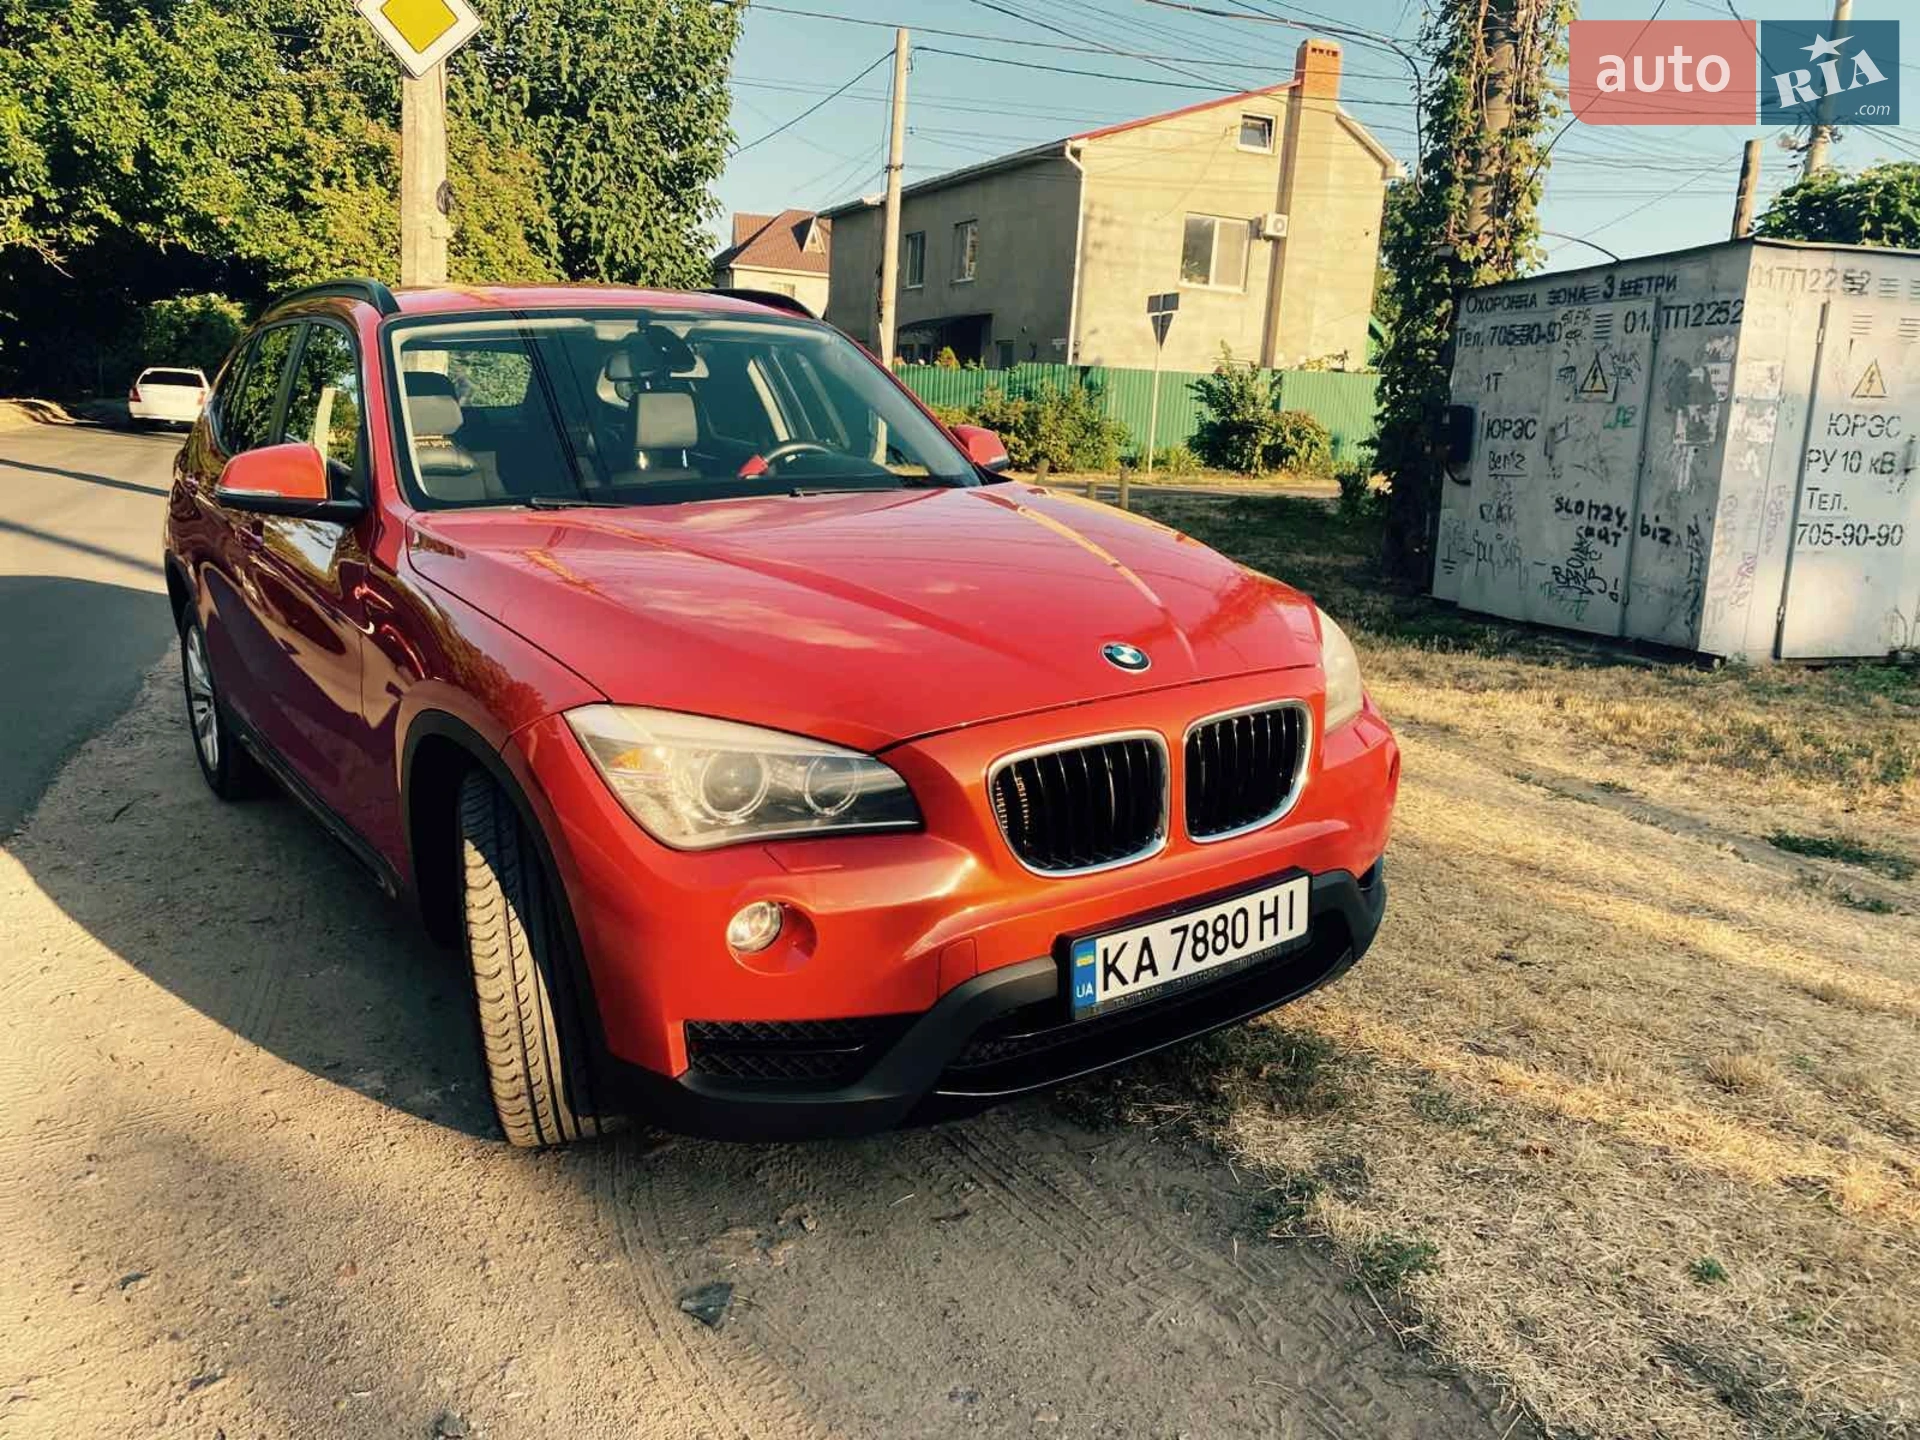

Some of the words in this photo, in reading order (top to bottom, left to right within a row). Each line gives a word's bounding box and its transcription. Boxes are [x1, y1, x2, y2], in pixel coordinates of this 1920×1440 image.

[1603, 274, 1615, 300] 3
[1485, 417, 1538, 441] ЮРЭС
[1826, 412, 1902, 439] ЮРЭС
[1806, 448, 1838, 473] РУ
[1841, 450, 1863, 474] 10
[1797, 523, 1904, 547] 705-90-90
[1103, 936, 1159, 992] KA
[1170, 907, 1249, 972] 7880
[1259, 889, 1294, 942] HI
[1075, 982, 1094, 999] UA
